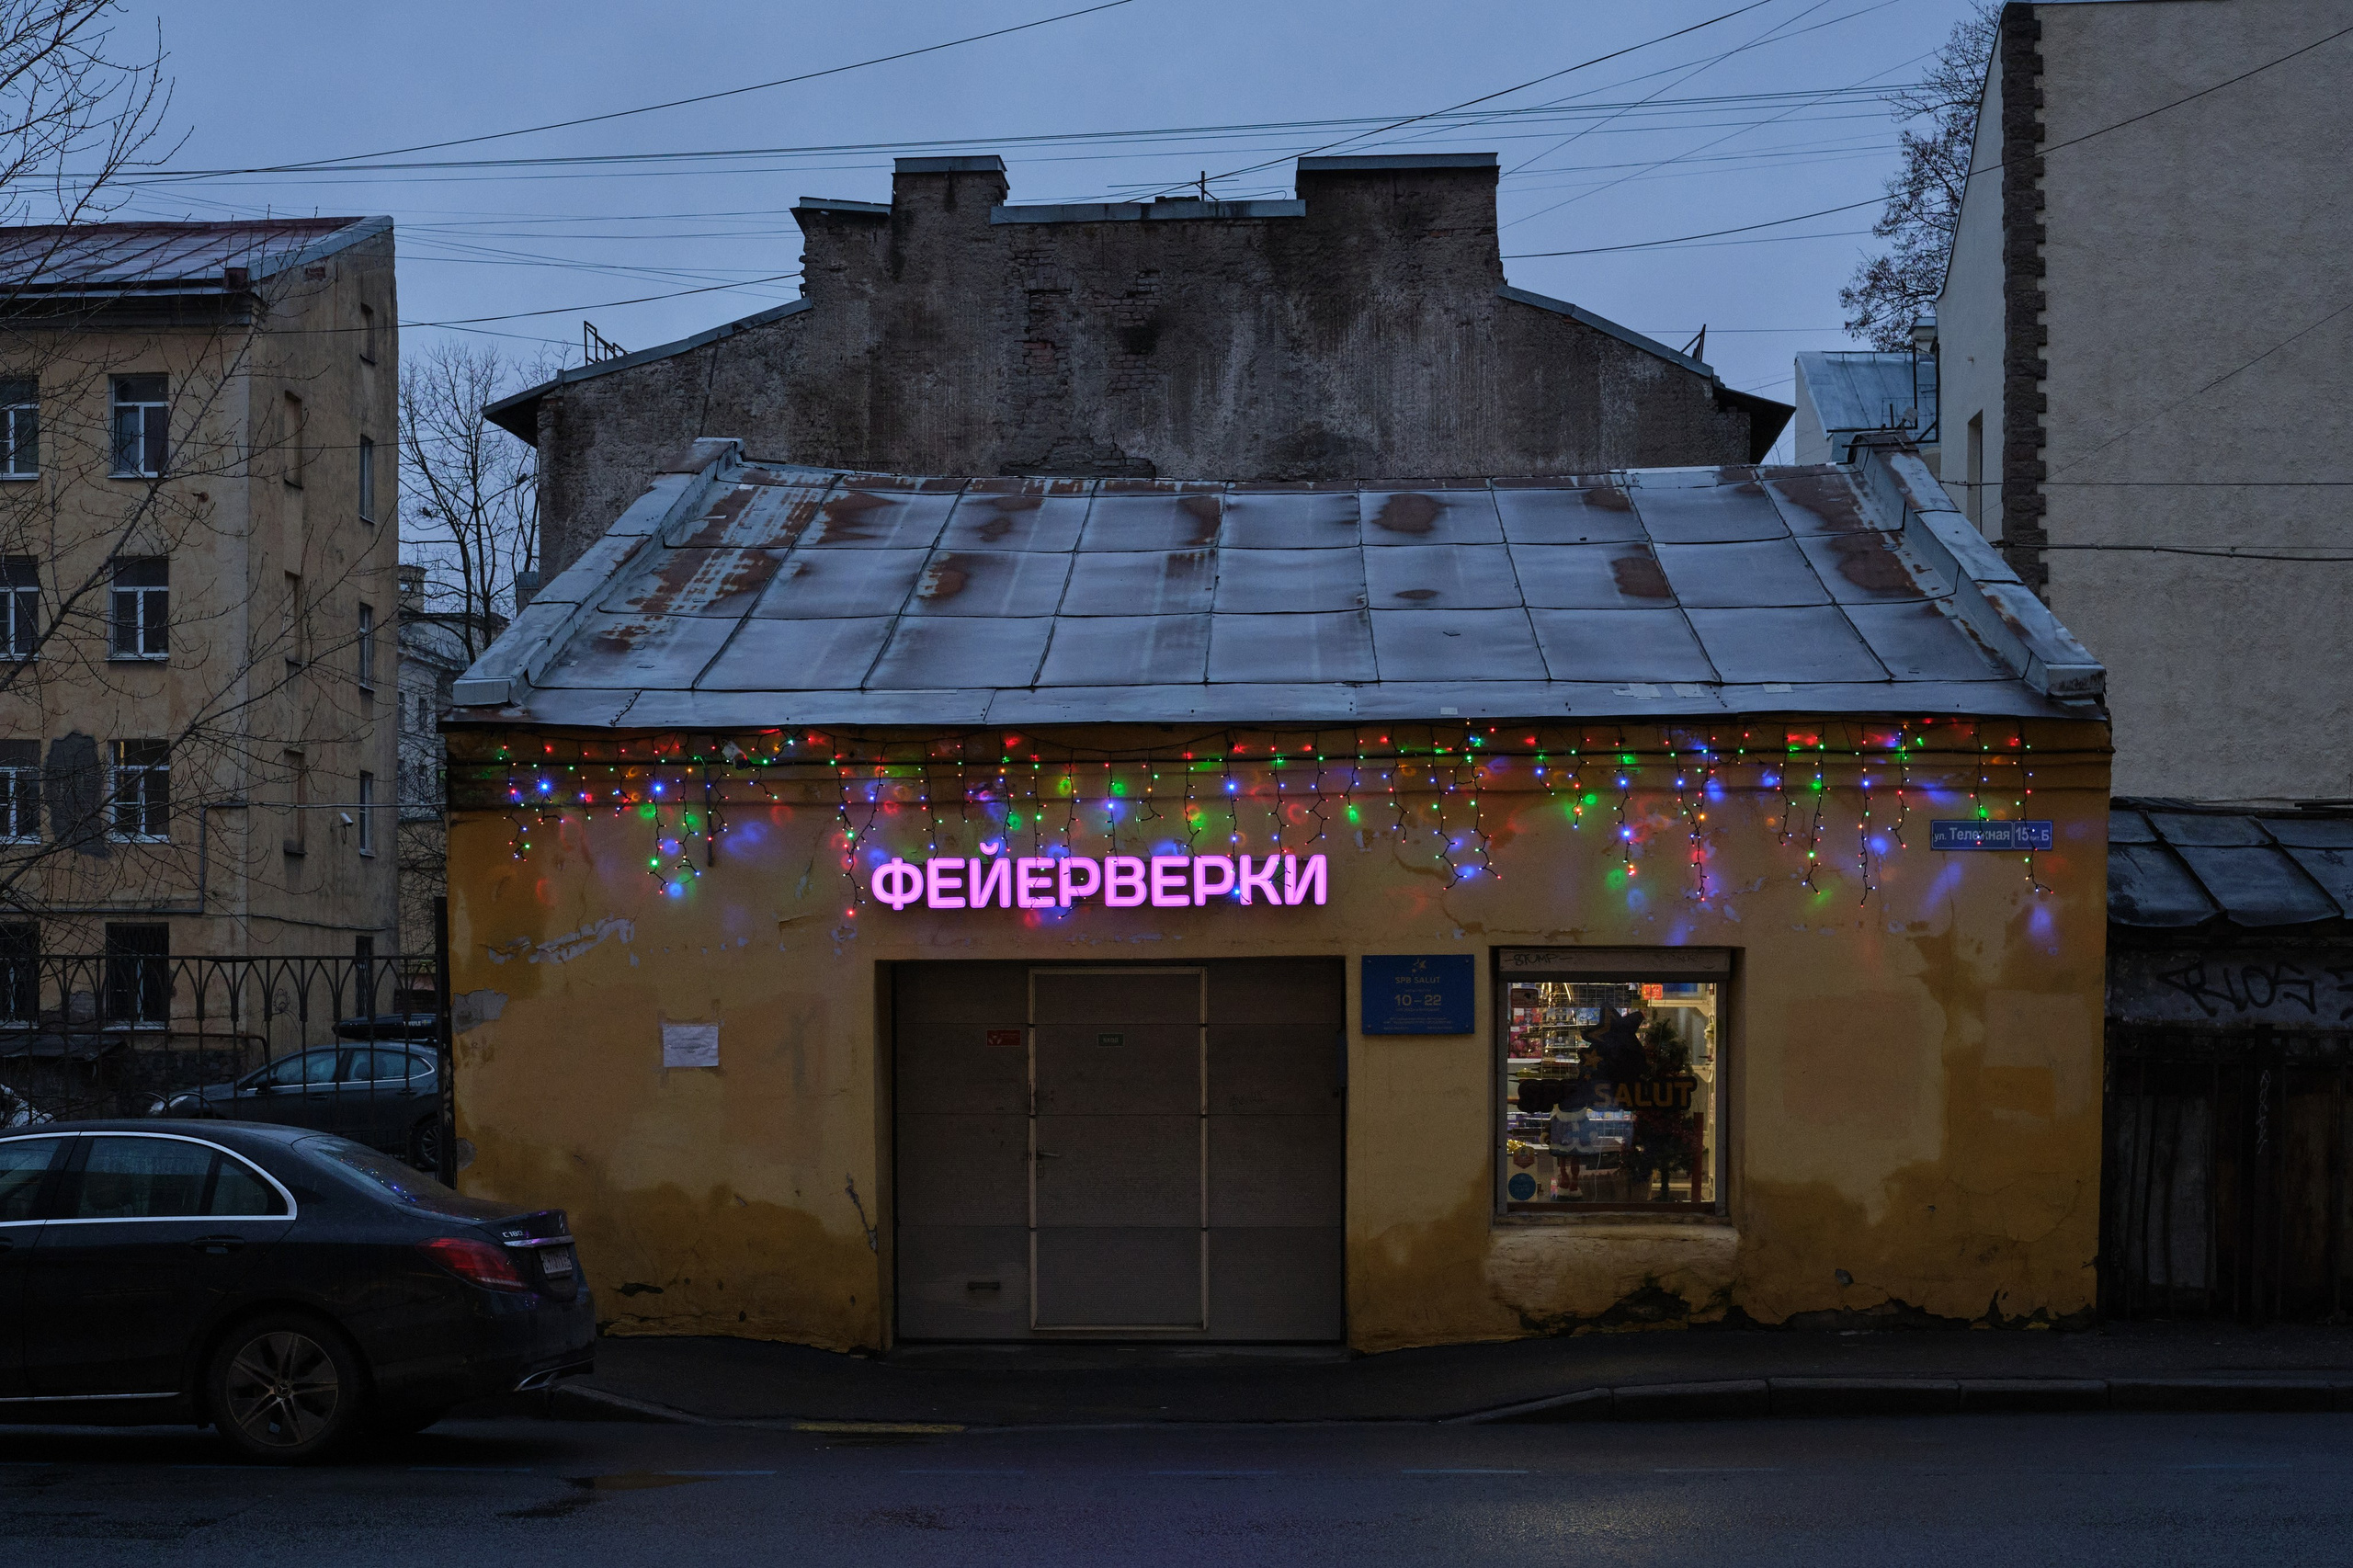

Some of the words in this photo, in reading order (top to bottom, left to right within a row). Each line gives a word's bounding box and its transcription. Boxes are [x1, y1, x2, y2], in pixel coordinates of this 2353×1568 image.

[1934, 833, 1947, 843] ул.
[1949, 827, 2010, 841] Тележная
[871, 842, 1327, 911] ФЕЙЕРВЕРКИ
[1594, 1081, 1694, 1108] SALUT
